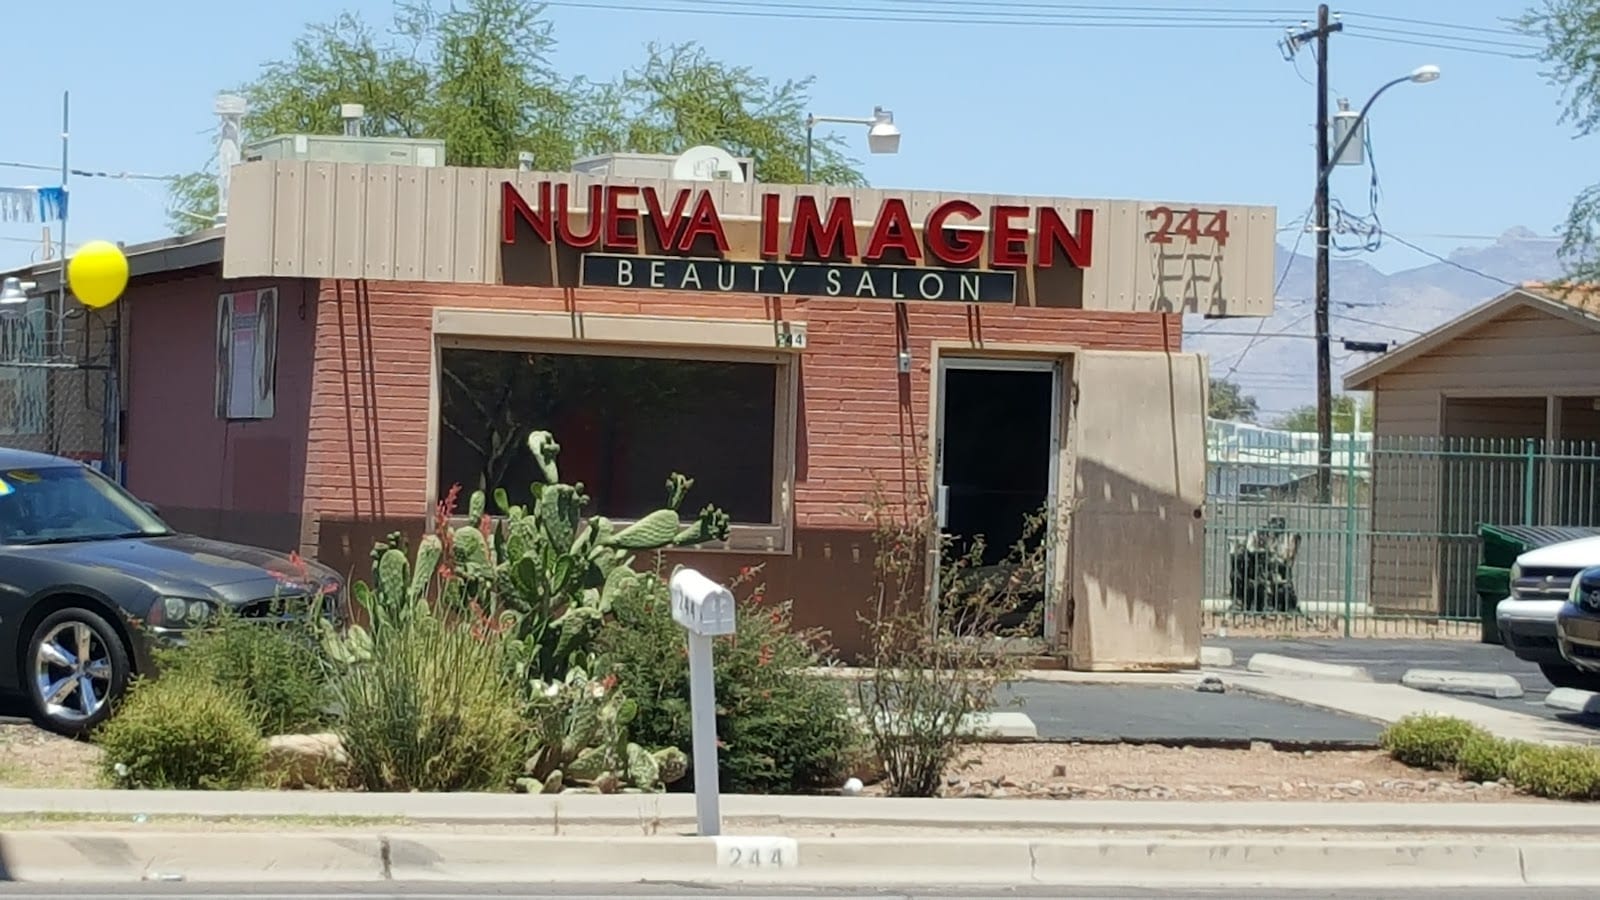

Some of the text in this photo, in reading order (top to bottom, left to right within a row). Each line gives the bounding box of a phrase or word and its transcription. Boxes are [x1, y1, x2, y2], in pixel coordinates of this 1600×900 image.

[501, 181, 1094, 268] NUEVA IMAGEN
[1149, 206, 1230, 246] 244
[617, 259, 980, 301] BEAUTY SALON
[777, 333, 802, 346] 244
[729, 846, 784, 867] 244
